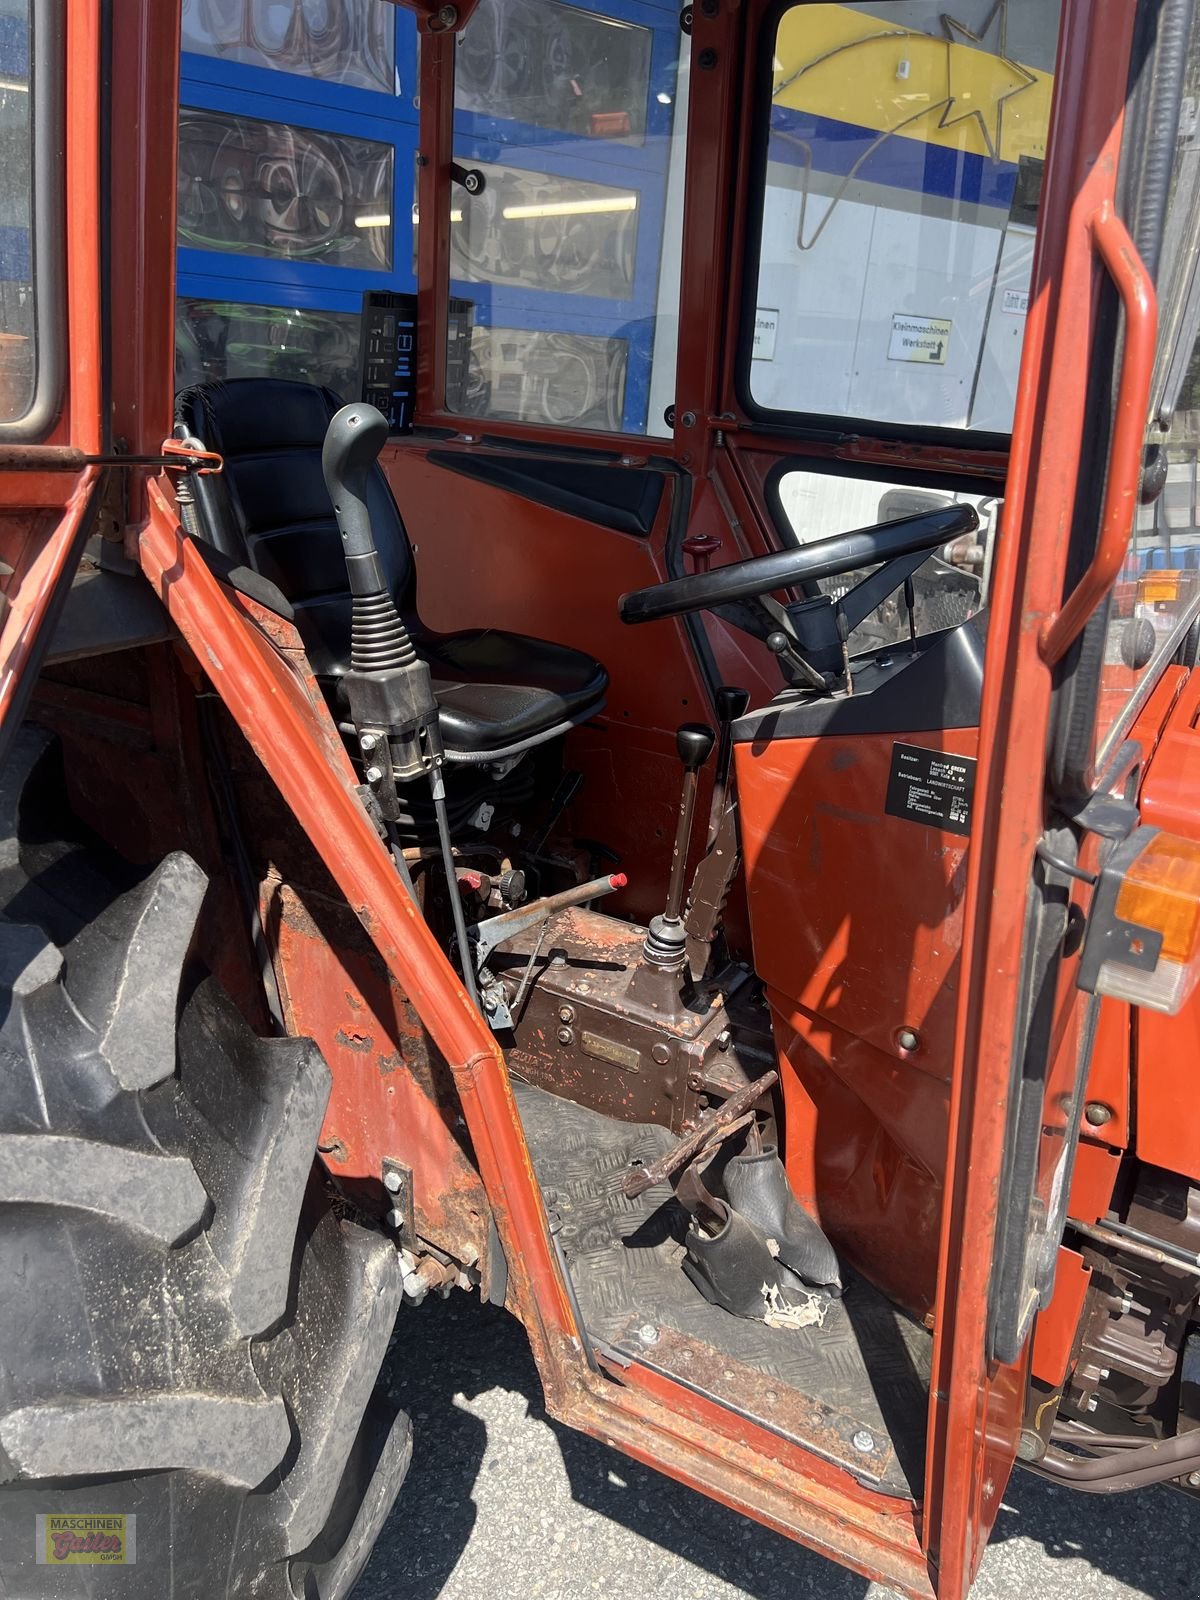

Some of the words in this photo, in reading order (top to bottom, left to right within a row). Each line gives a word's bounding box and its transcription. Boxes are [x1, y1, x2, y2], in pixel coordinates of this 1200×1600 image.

[893, 321, 949, 336] Kleinmaschinen
[902, 338, 936, 349] Werkstatt
[926, 779, 966, 792] LANDWIRTSCHAFT
